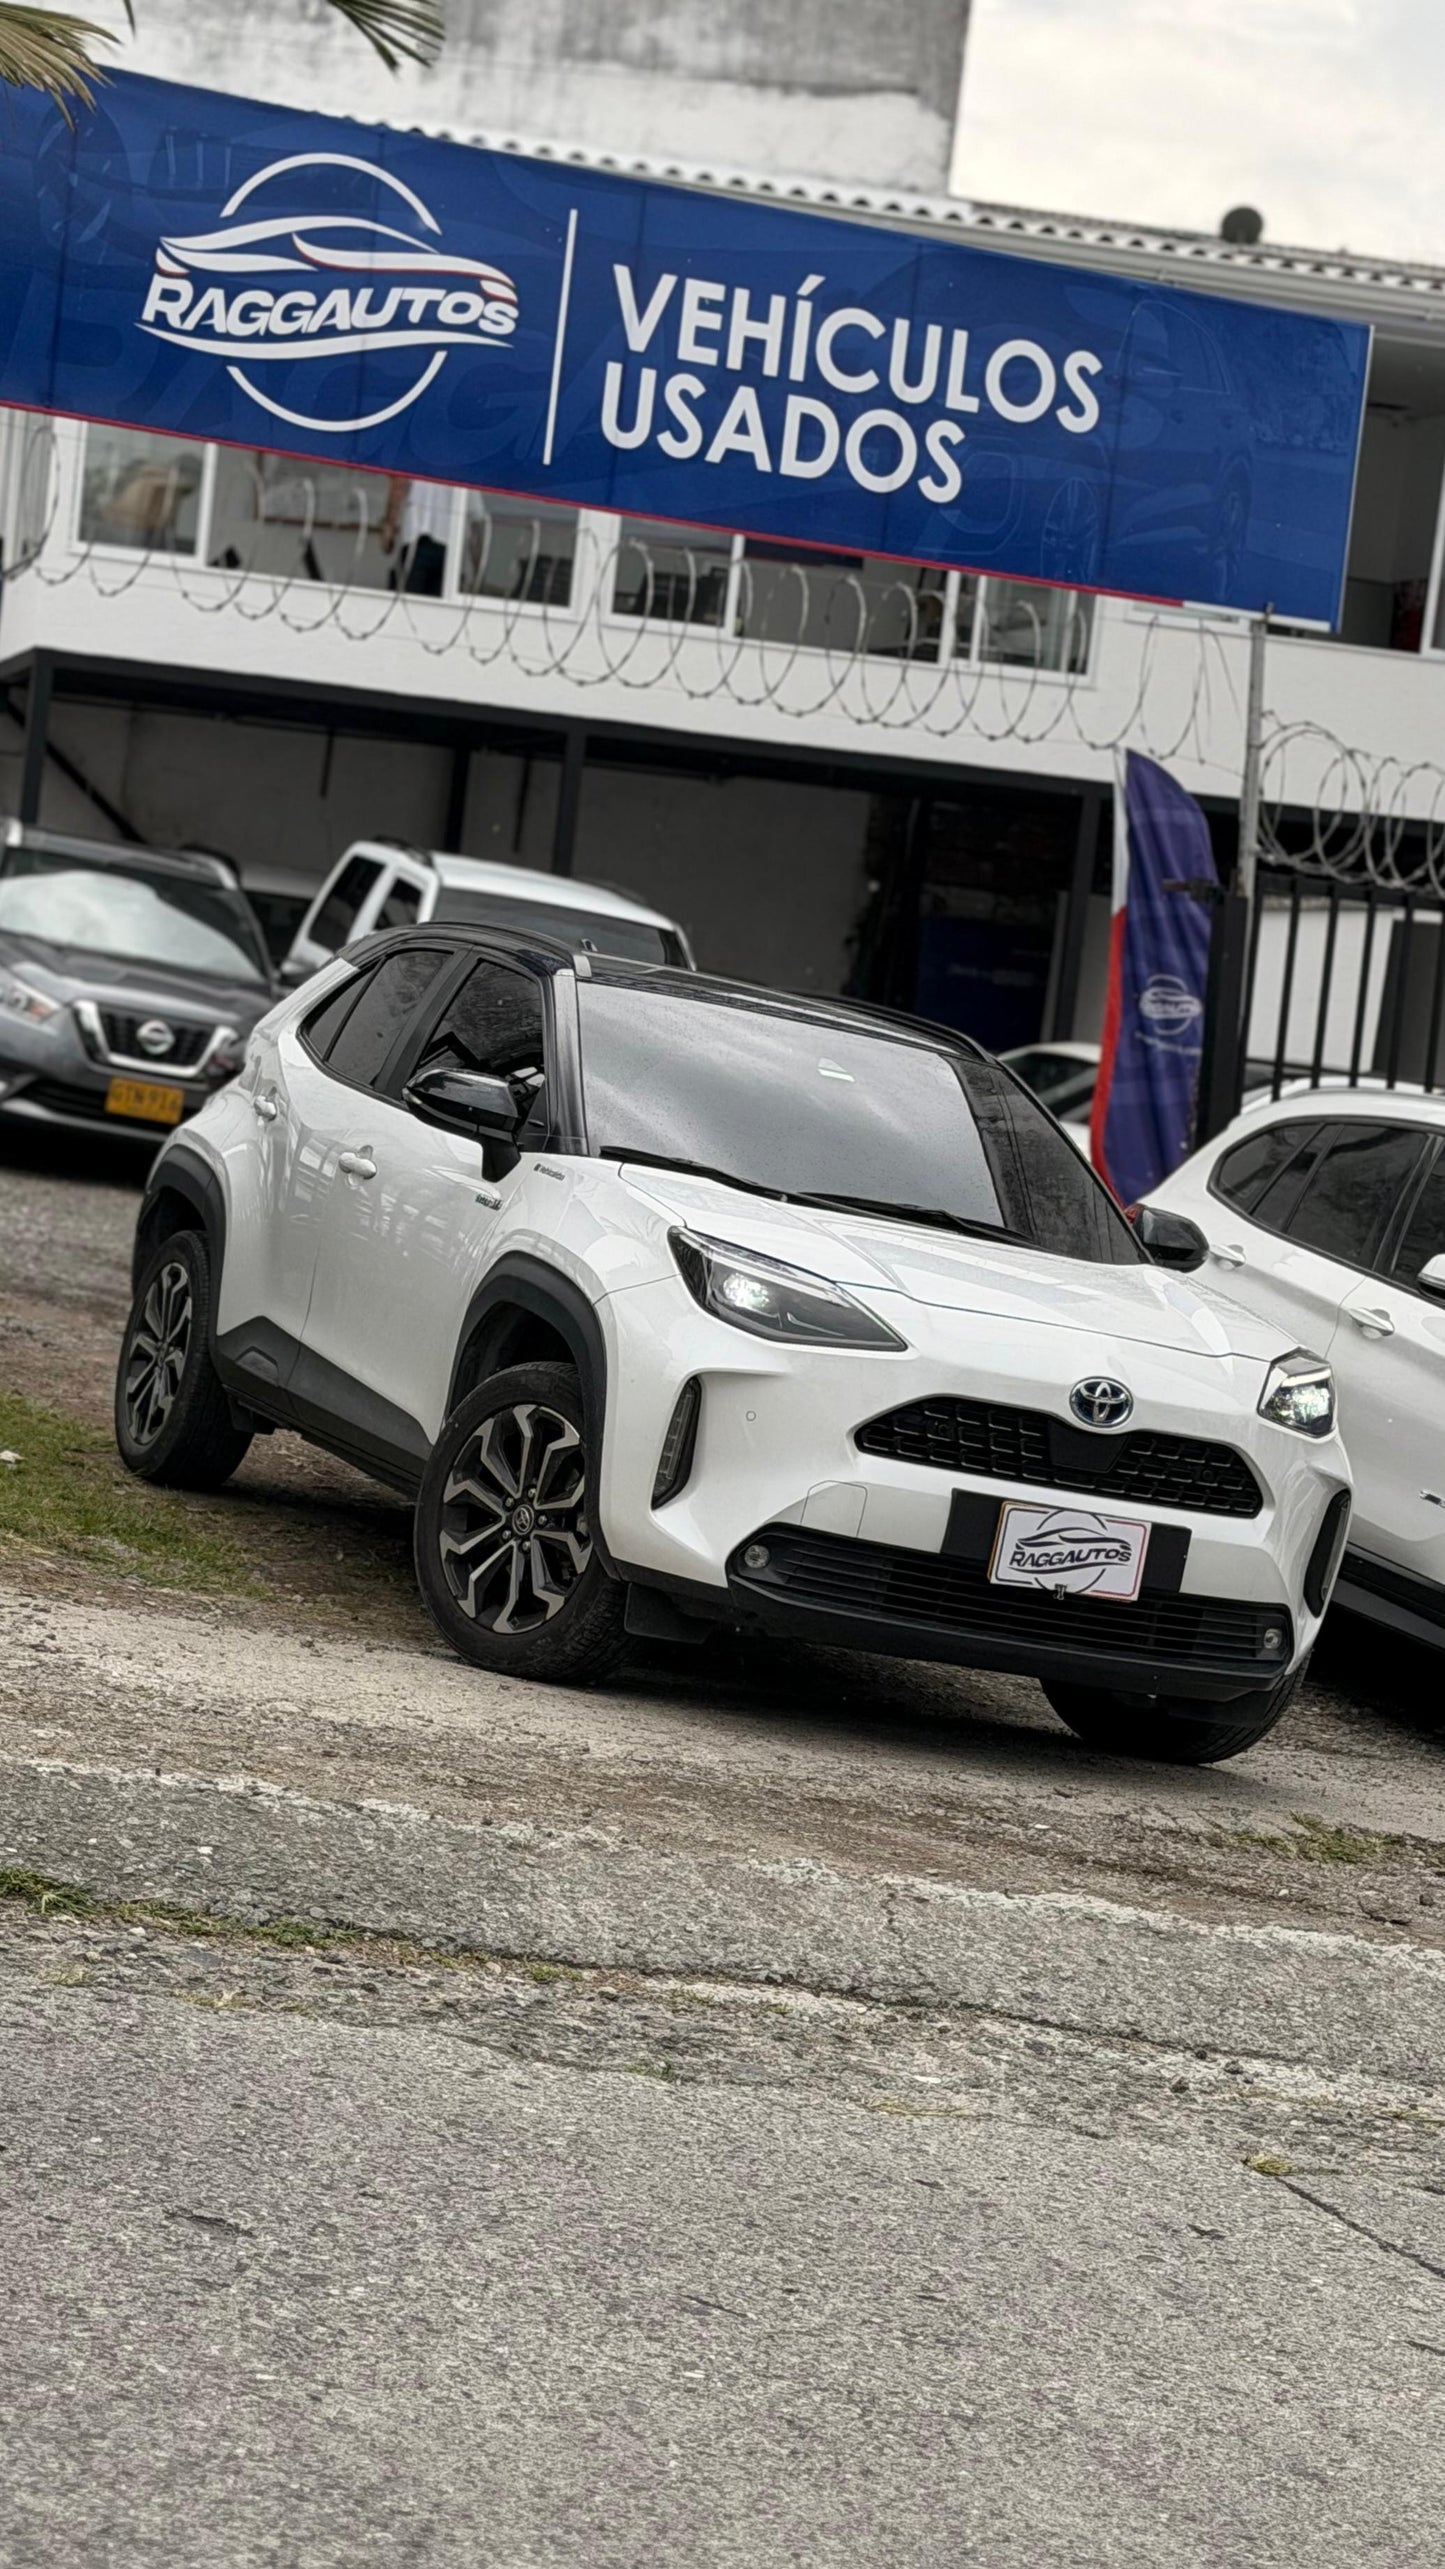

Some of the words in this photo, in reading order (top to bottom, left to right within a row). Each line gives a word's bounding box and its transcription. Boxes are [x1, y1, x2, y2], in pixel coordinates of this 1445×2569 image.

[141, 273, 519, 337] RAGGAUTOS
[613, 263, 1103, 434] VEHÍCULOS
[601, 361, 965, 503] USADOS
[1009, 1548, 1132, 1567] RAGGAUTOS
